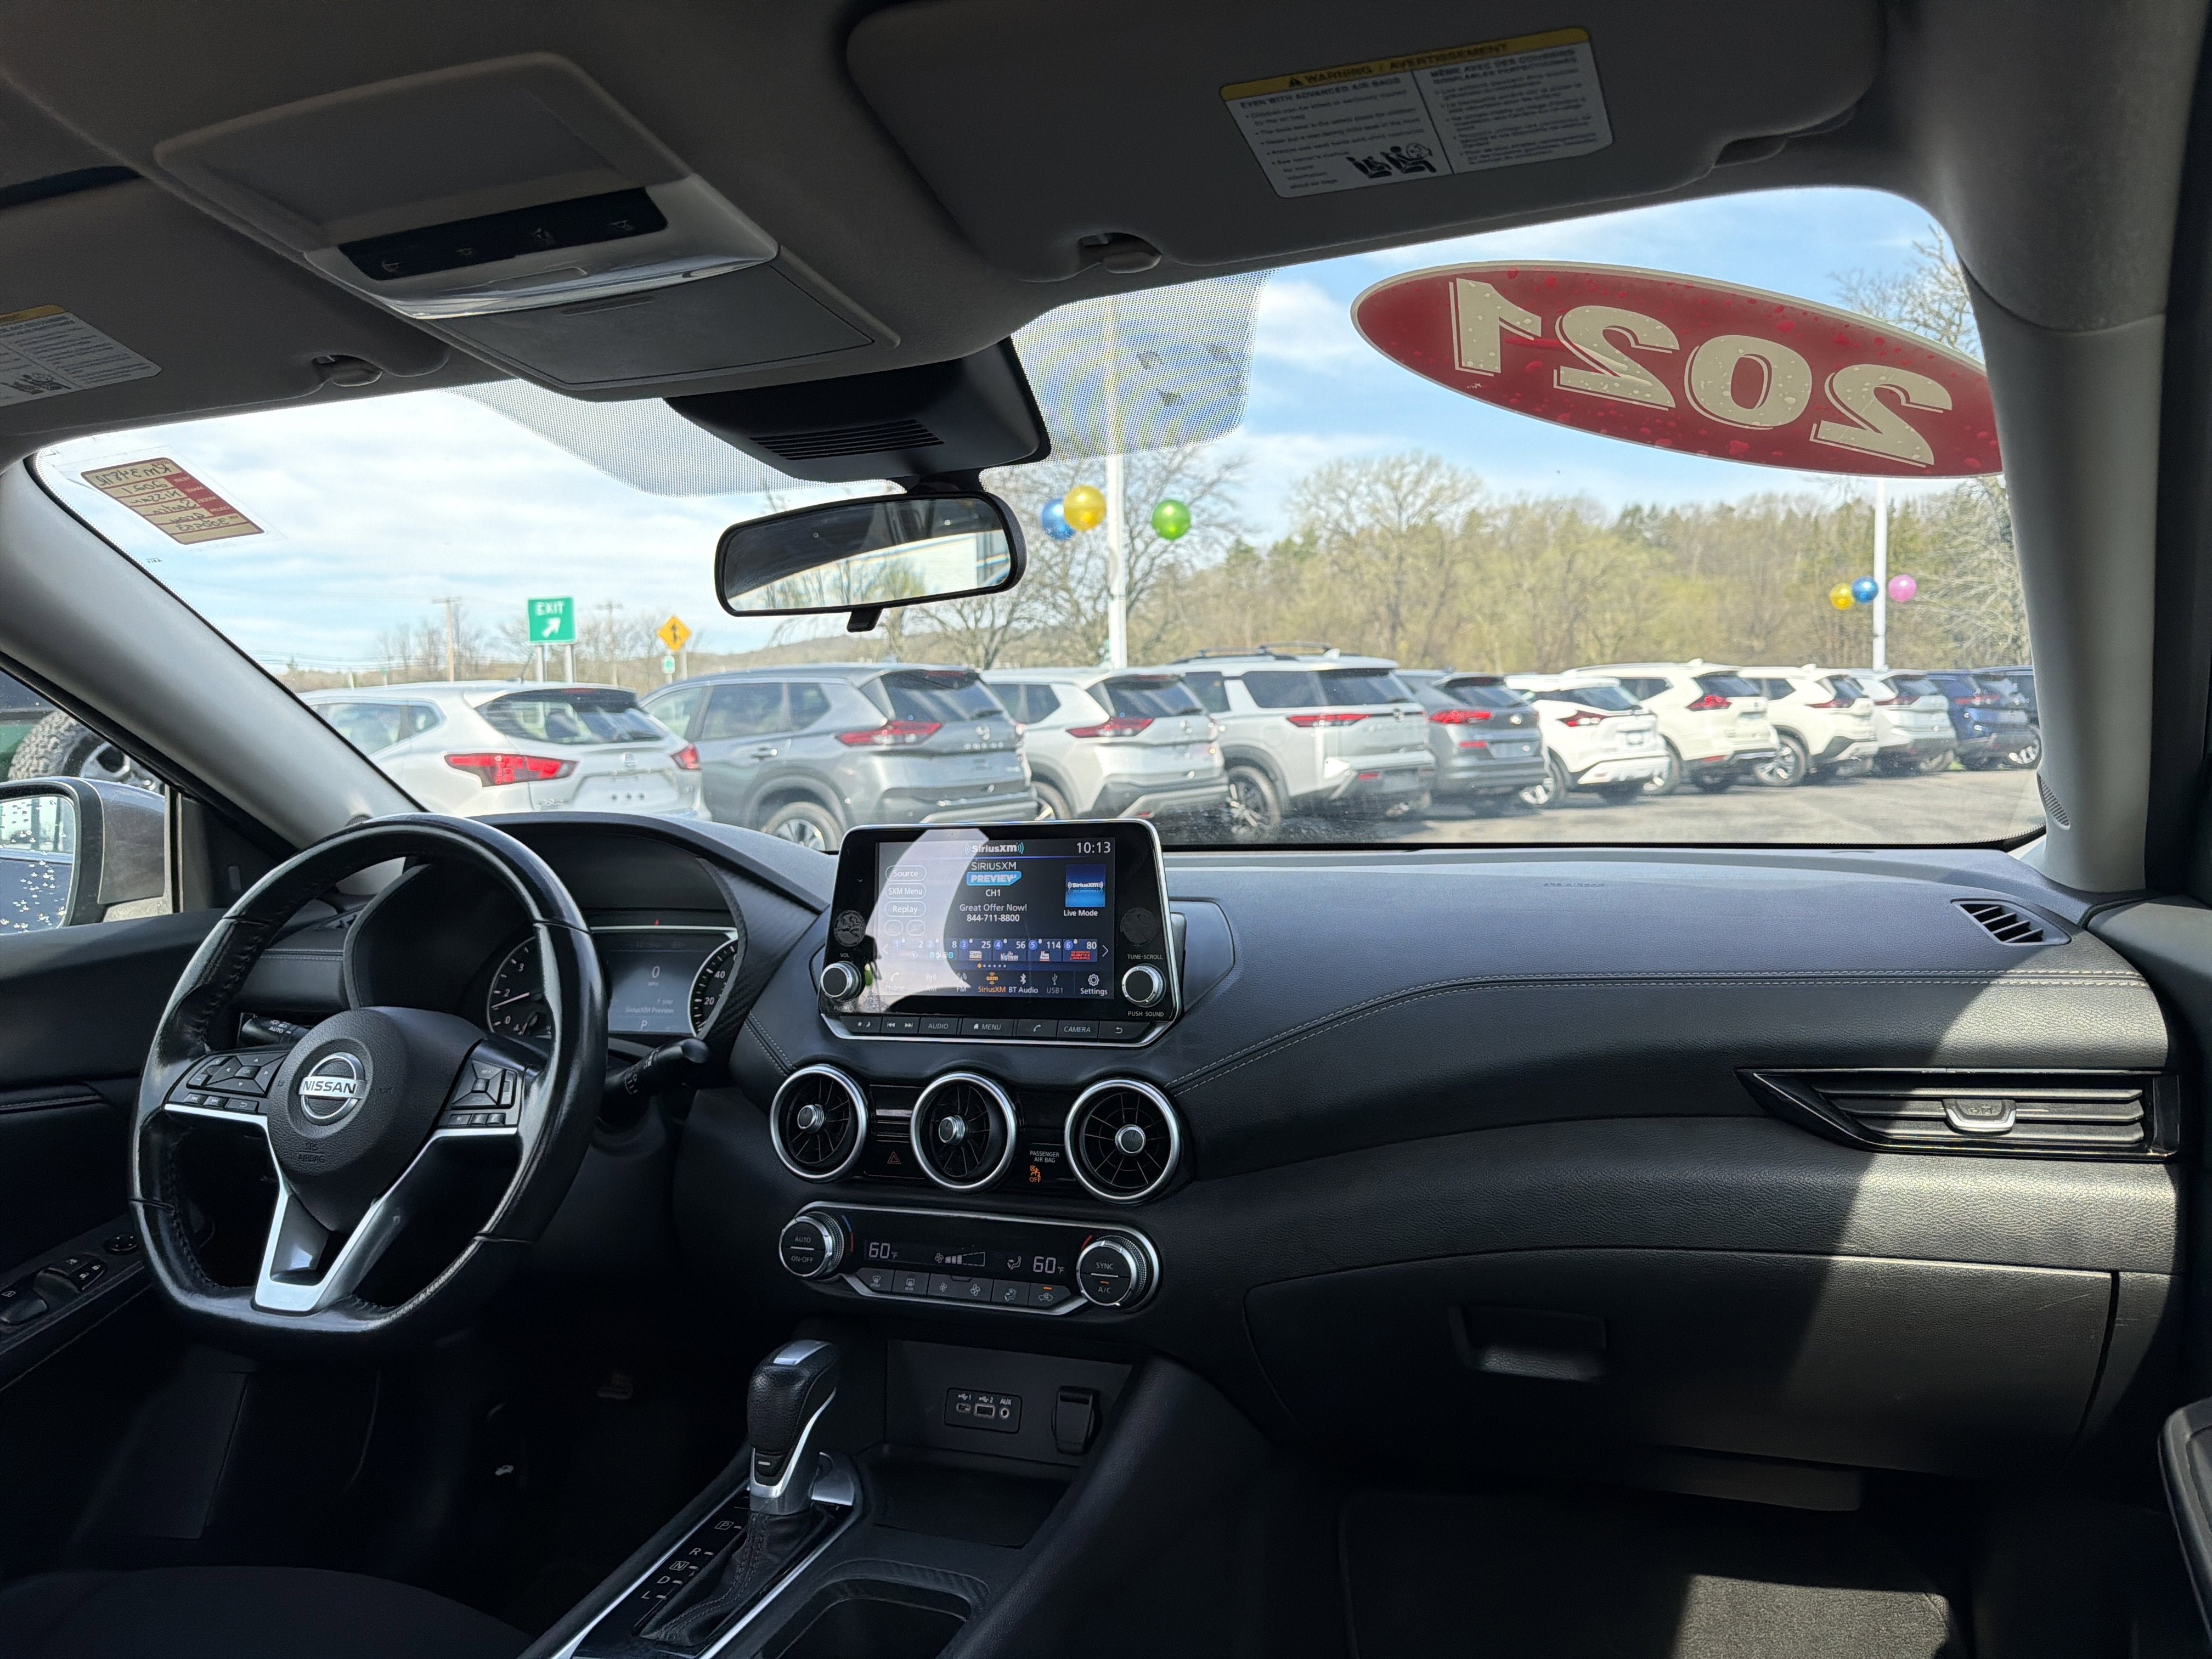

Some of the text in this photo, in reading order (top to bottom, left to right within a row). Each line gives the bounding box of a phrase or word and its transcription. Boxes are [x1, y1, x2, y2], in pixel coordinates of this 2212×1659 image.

[535, 601, 565, 616] EXIT
[1076, 842, 1111, 854] 10:13
[971, 861, 1016, 870] SIRIUSXM
[893, 905, 918, 914] Replay
[981, 941, 991, 949] 25
[1015, 941, 1026, 949] 56
[1046, 941, 1061, 949] 114
[1086, 941, 1097, 950] 80
[518, 963, 524, 972] 3
[651, 966, 660, 978] 0
[714, 970, 726, 979] 40
[504, 988, 511, 997] 2
[1080, 988, 1108, 996] Settings
[703, 997, 715, 1006] 20
[505, 1015, 511, 1025] 0
[268, 1025, 284, 1034] AUTO
[640, 1020, 648, 1030] P
[302, 1080, 357, 1094] NISSAN
[868, 1242, 890, 1260] 60
[1033, 1256, 1056, 1274] 60
[1096, 1262, 1114, 1270] SYNC
[689, 1548, 702, 1556] R
[657, 1576, 670, 1584] D
[641, 1590, 651, 1600] L
